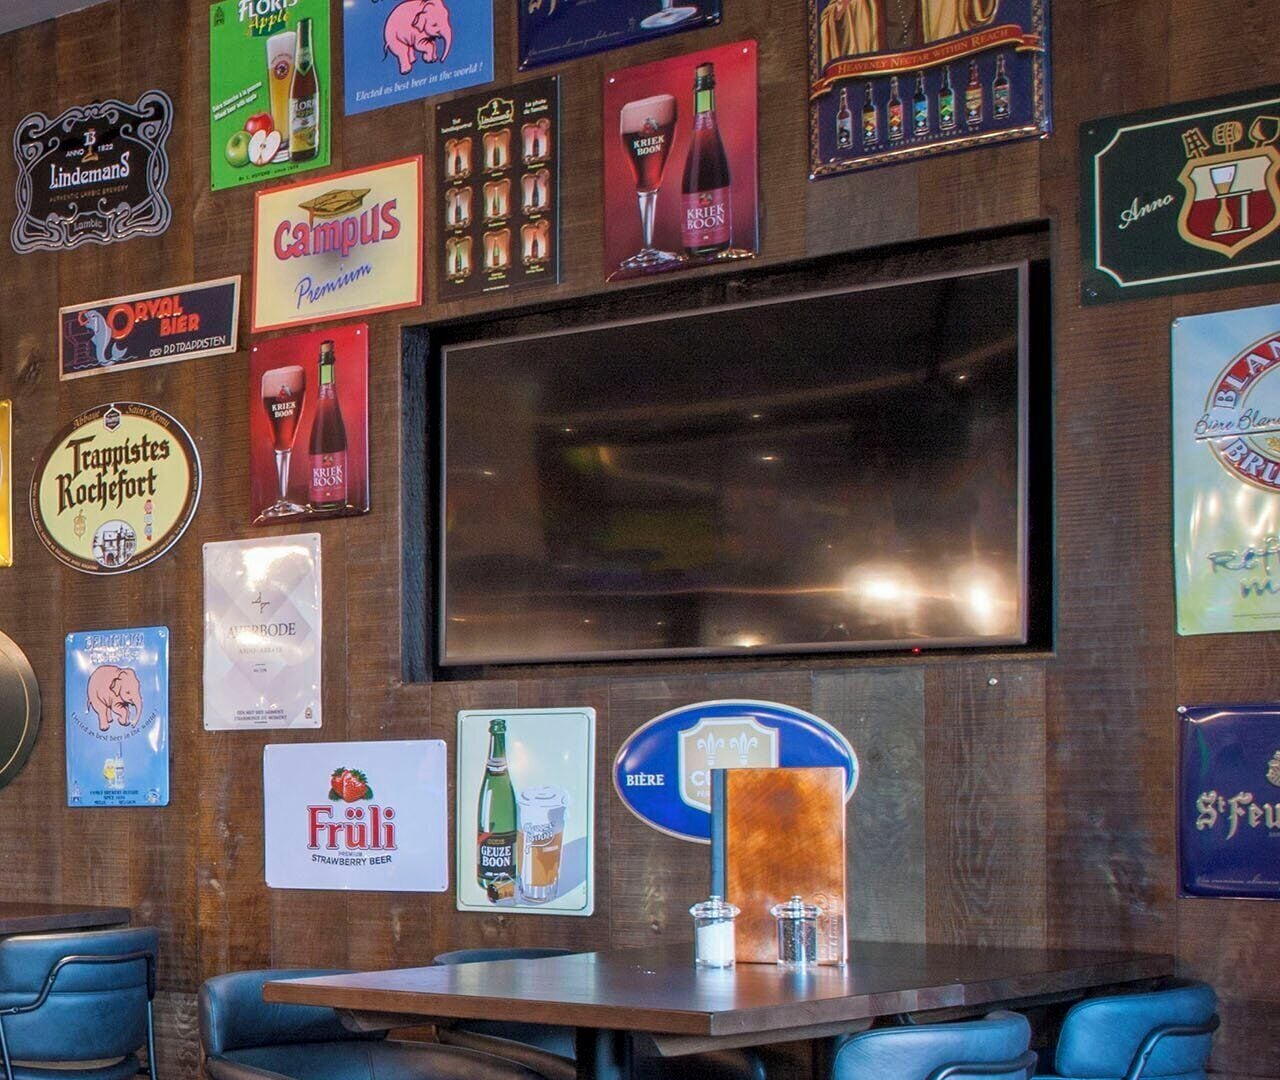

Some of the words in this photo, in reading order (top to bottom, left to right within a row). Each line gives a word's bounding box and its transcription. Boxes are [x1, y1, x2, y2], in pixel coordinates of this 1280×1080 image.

[248, 10, 290, 34] Apple
[355, 87, 383, 101] Elected
[384, 86, 393, 95] as
[394, 81, 410, 92] best
[411, 76, 427, 88] beer
[429, 74, 438, 83] in
[439, 70, 452, 81] the
[453, 64, 478, 78] world
[633, 134, 665, 149] KRIEK
[65, 148, 85, 158] ANNO
[637, 144, 662, 156] BOON
[687, 202, 725, 220] KRIEK
[1118, 194, 1175, 230] Anno
[73, 218, 103, 232] Lambic
[687, 213, 725, 230] BOON
[274, 198, 401, 261] Campus
[294, 261, 373, 309] Premium
[107, 295, 184, 340] ORVAL
[159, 313, 201, 337] BIER
[149, 348, 162, 358] DER
[272, 401, 296, 411] KRIEK
[274, 409, 294, 418] BOON
[65, 433, 170, 481] Trappistes
[313, 465, 343, 479] KRIEK
[313, 475, 343, 487] BOON
[55, 467, 158, 516] Rochefort
[626, 771, 665, 786] BIÈRE
[306, 804, 398, 851] Früli
[481, 845, 512, 857] GEUZE
[311, 853, 367, 866] STRAWBERRY
[369, 854, 392, 866] BEER
[482, 855, 512, 867] BOON
